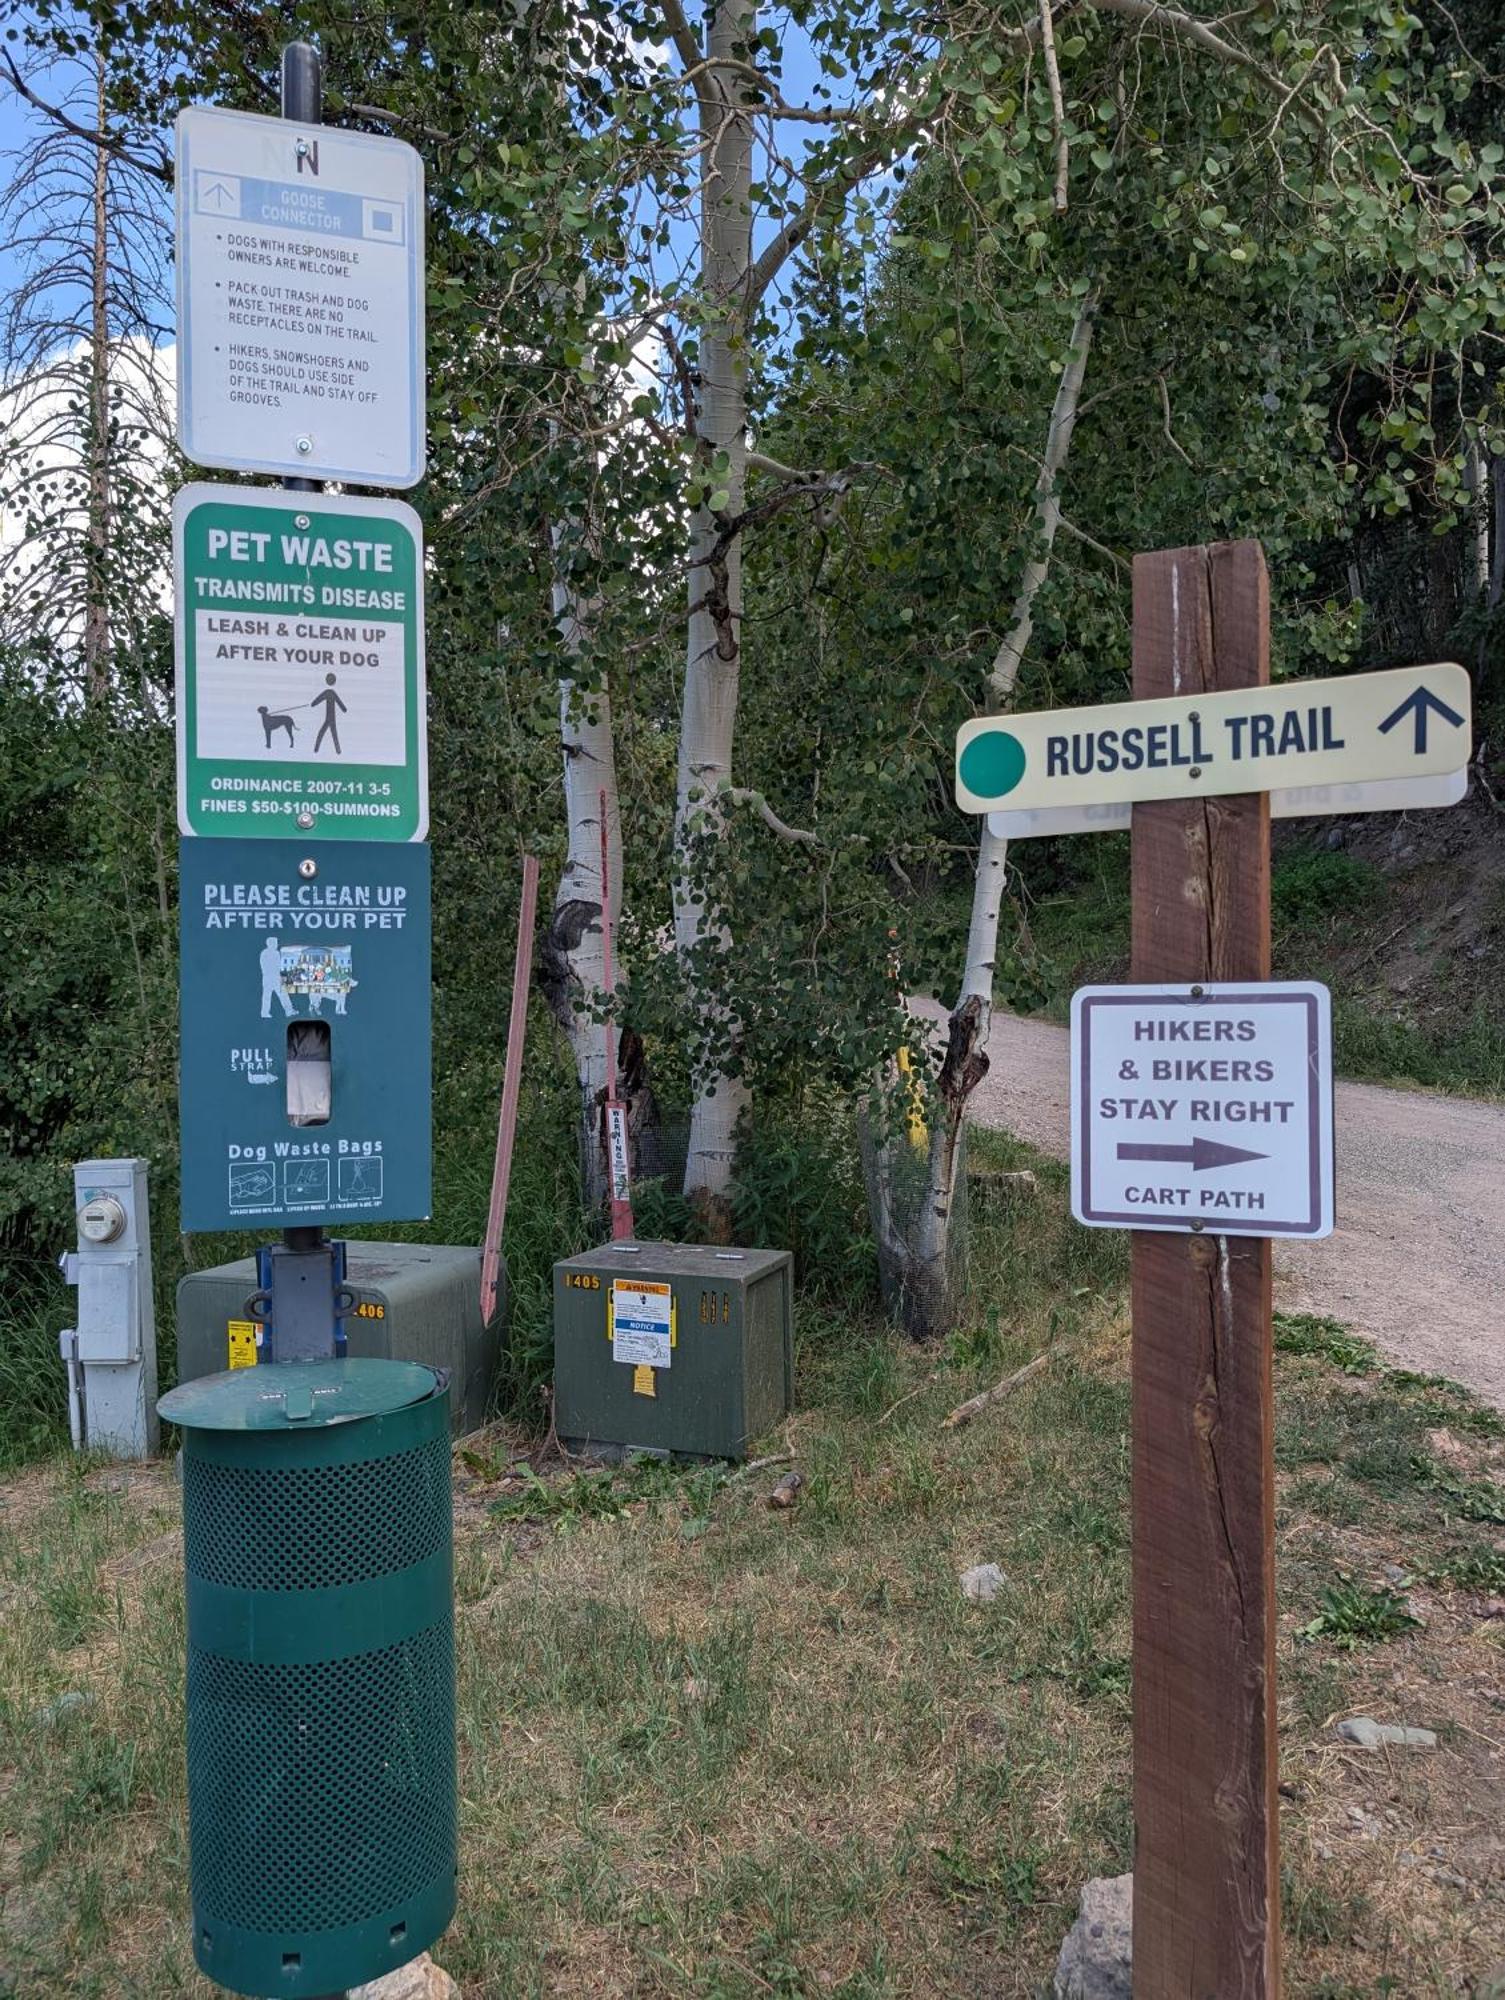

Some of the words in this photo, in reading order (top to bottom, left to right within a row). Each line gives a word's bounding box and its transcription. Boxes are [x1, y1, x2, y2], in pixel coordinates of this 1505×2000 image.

[280, 190, 326, 212] GOOSE
[261, 204, 342, 230] CONNECTOR
[227, 233, 257, 249] DOGS
[259, 239, 285, 254] WITH
[288, 243, 360, 265] RESPONSIBLE
[227, 250, 273, 267] OWNERS
[275, 257, 297, 271] ARE
[228, 280, 258, 296] PACK
[260, 285, 282, 300] OUT
[284, 288, 320, 304] TRASH
[322, 293, 344, 309] AND
[347, 298, 369, 312] DOG
[268, 302, 302, 318] THERE
[304, 306, 326, 322] ARE
[328, 310, 344, 324] NO
[228, 312, 305, 334] RECEPTACLES
[307, 323, 322, 336] ON
[325, 325, 345, 339] THE
[229, 359, 259, 374] DOGS
[261, 363, 305, 380] SHOULD
[308, 371, 329, 383] USE
[331, 372, 355, 386] SIDE
[273, 349, 345, 370] SNOWSHOERS
[347, 358, 370, 373] AND
[230, 375, 243, 387] OF
[246, 377, 267, 391] THE
[269, 379, 300, 394] TRAIL
[302, 384, 326, 398] AND
[328, 387, 356, 402] STAY
[358, 391, 378, 404] OFF
[208, 528, 272, 563] PET
[280, 534, 393, 573] WASTE
[194, 576, 316, 605] TRANSMITS
[321, 586, 406, 611] DISEASE
[207, 617, 270, 637] LEASH
[276, 622, 290, 637] &
[295, 623, 357, 642] CLEAN
[362, 628, 387, 643] UP
[216, 643, 278, 663] AFTER
[283, 648, 335, 666] YOUR
[339, 652, 380, 668] DOG
[1046, 720, 1213, 777] RUSSELL
[1224, 706, 1345, 761] TRAIL
[210, 777, 303, 794] ORDINANCE
[306, 780, 364, 795] 2007-11
[368, 783, 391, 796] 3-5
[200, 799, 247, 813] FINES
[204, 884, 290, 906] PLEASE
[297, 885, 371, 907] CLEAN
[376, 886, 407, 907] UP
[205, 911, 284, 930] AFTER
[289, 911, 357, 930] YOUR
[364, 912, 407, 930] PET
[1134, 1020, 1257, 1042] HIKERS
[230, 1062, 273, 1072] STRAP
[231, 1048, 274, 1063] PULL
[1118, 1059, 1140, 1081] &
[1152, 1060, 1275, 1082] BIKERS
[1099, 1098, 1179, 1121] STAY
[1190, 1100, 1295, 1124] RIGHT
[228, 1144, 267, 1161] Dog
[274, 1142, 331, 1157] Waste
[338, 1139, 383, 1156] Bags
[1124, 1186, 1192, 1206] CART
[1199, 1189, 1265, 1209] PATH
[354, 1304, 385, 1319] 406
